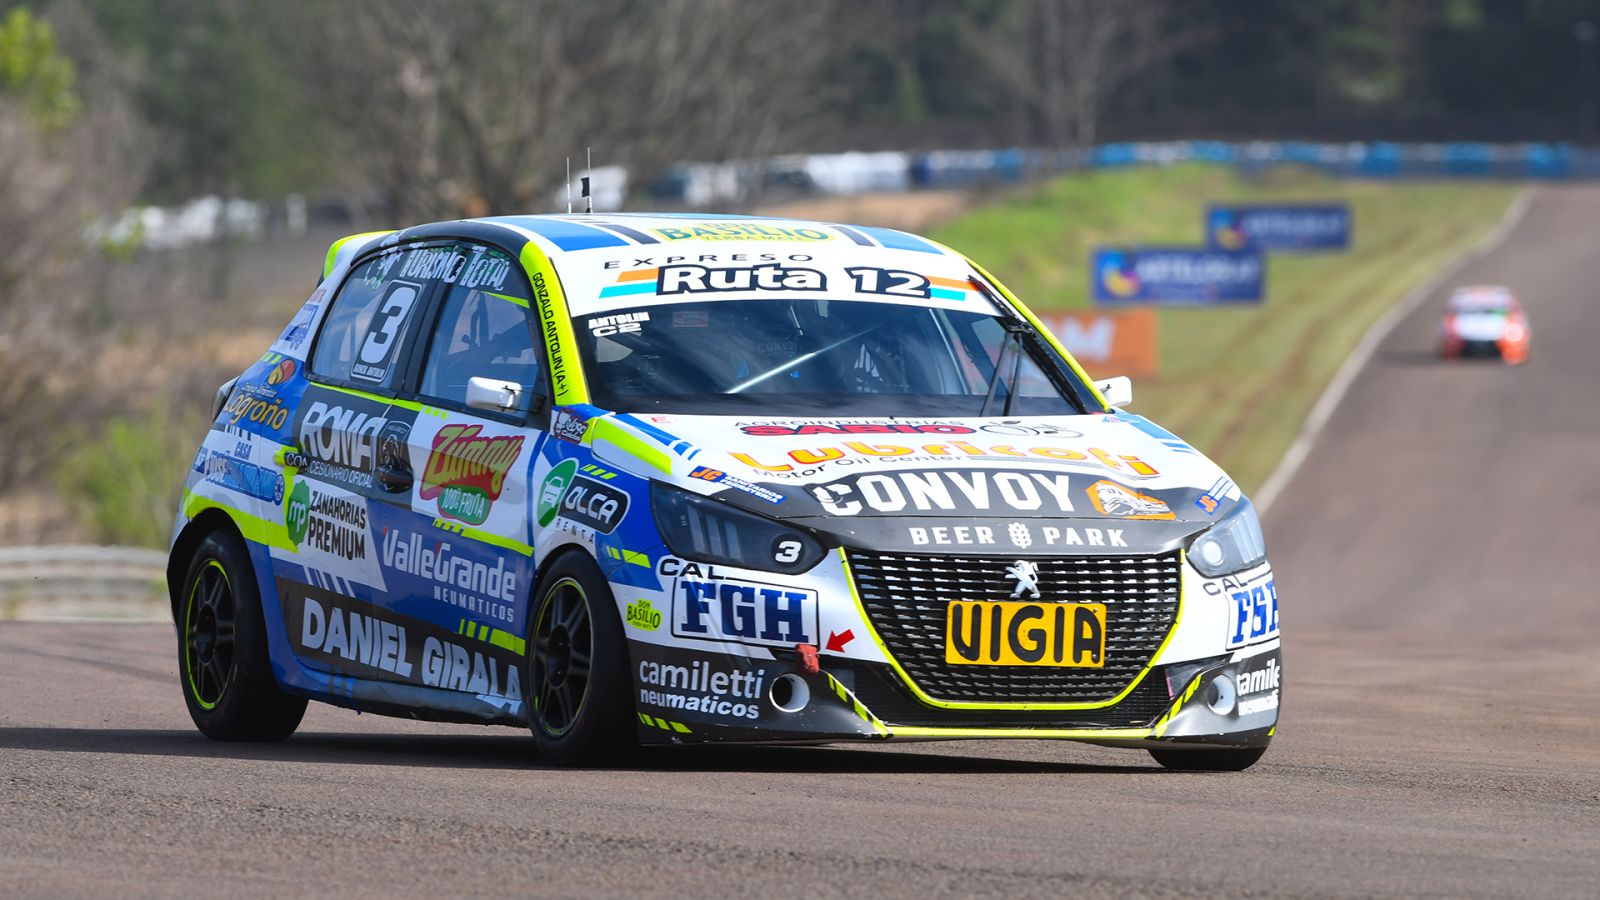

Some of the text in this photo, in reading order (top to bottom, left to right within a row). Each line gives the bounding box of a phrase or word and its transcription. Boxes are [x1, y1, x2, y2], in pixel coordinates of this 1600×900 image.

[656, 226, 829, 241] BASILIO
[400, 242, 467, 283] TURISMO
[459, 245, 510, 291] TOTAL
[604, 253, 813, 270] EXPRESO
[659, 265, 931, 298] Ruta 12
[360, 286, 417, 364] 3
[533, 272, 569, 397] GONZALO ANTOLIN (A+)
[592, 322, 642, 337] C2
[300, 401, 388, 472] ROMA
[740, 424, 977, 436] SABIO
[691, 468, 722, 481] JC
[752, 455, 962, 479] Motor Oil Center
[458, 492, 485, 518] FRUTA
[811, 471, 1075, 516] CONVOY
[310, 490, 366, 530] ZANAHORIAS
[307, 518, 366, 560] PREMIUM
[909, 525, 1129, 547] BEER PARK
[775, 541, 802, 563] 3
[660, 558, 726, 580] CAL
[1202, 575, 1248, 597] CAL
[434, 585, 515, 623] NEUMATICOS
[627, 605, 661, 629] BASILIO
[681, 580, 809, 643] FGH
[301, 597, 523, 714] DANIEL GIRALA
[639, 660, 765, 699] camiletti
[640, 688, 760, 719] neumaticos
